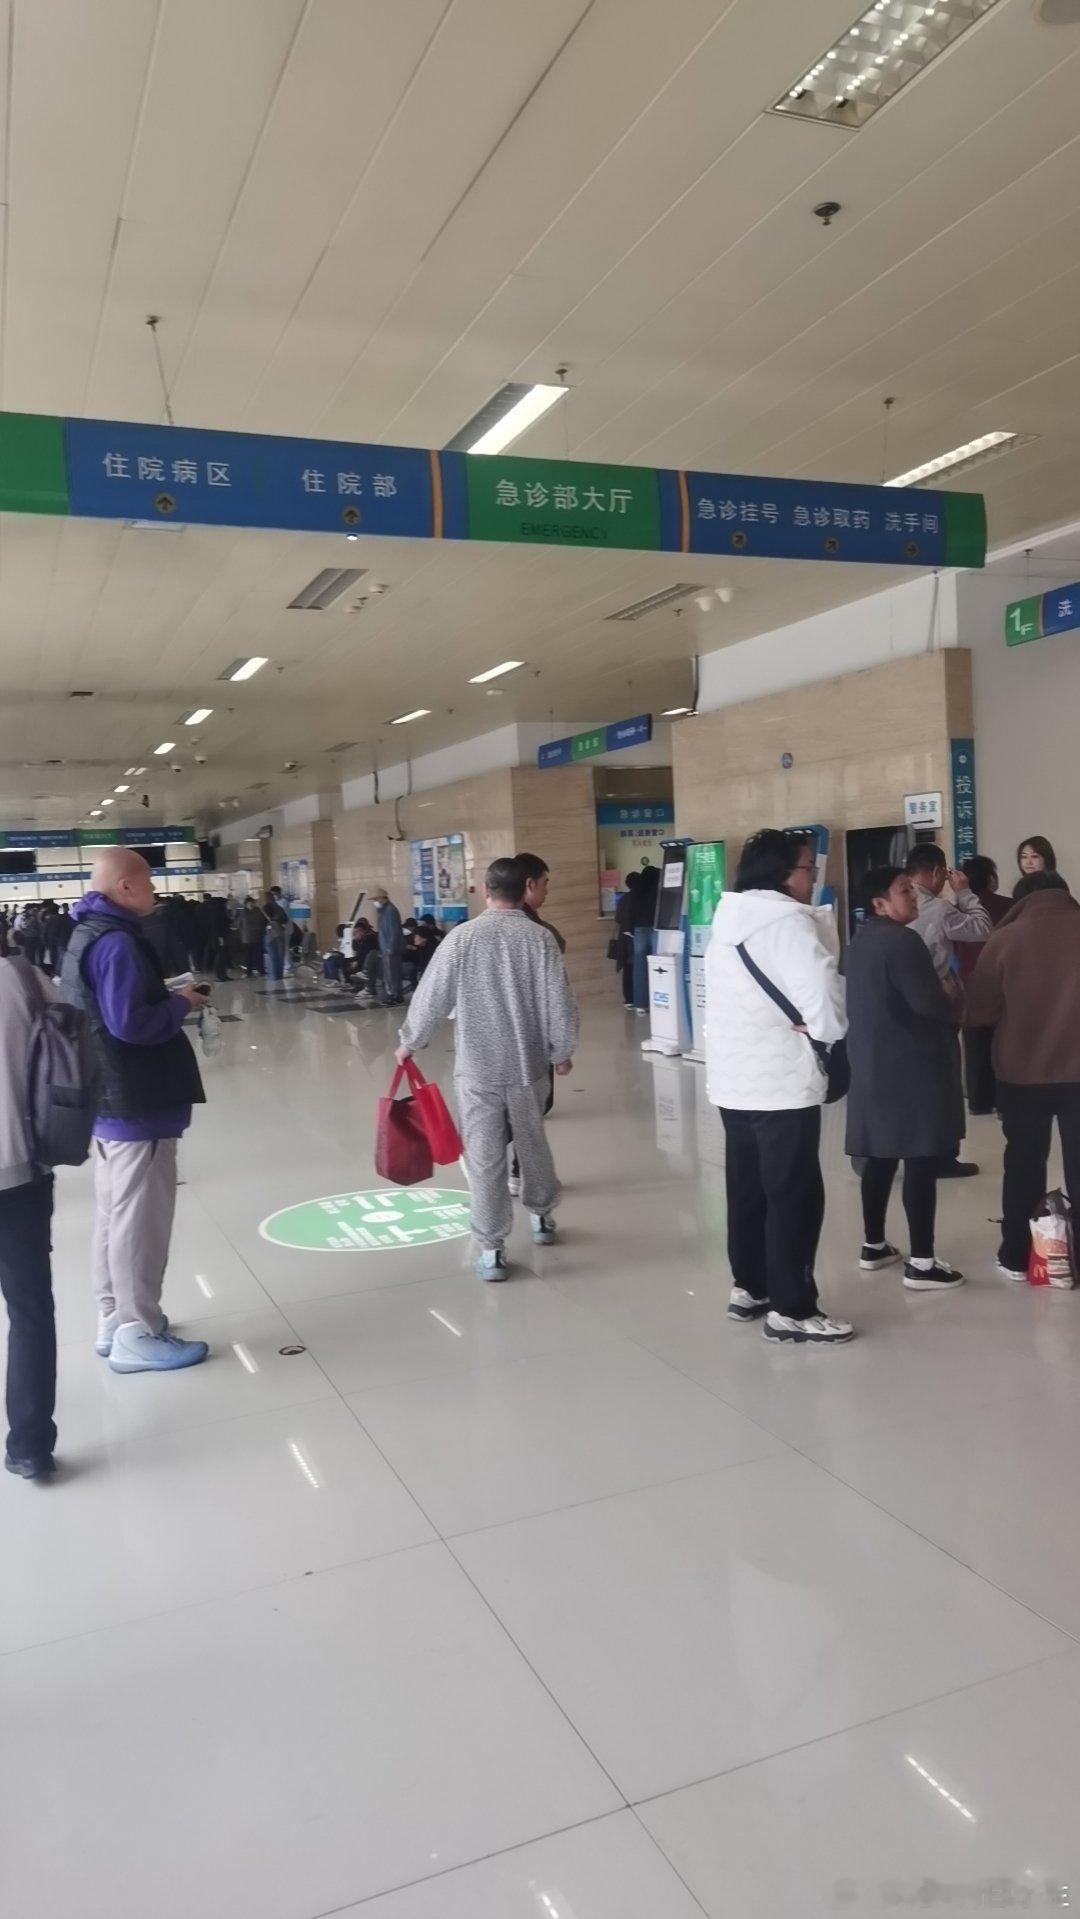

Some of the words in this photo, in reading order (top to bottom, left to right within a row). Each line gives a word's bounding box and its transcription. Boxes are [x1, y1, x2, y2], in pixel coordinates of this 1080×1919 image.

[103, 452, 232, 488] 住院病区
[301, 469, 398, 498] 住院部
[495, 478, 633, 514] 急诊部大厅
[520, 522, 609, 540] EMERGENCY
[697, 497, 779, 525] 急诊挂号
[793, 505, 871, 530] 急诊取药
[884, 511, 939, 534] 洗手间
